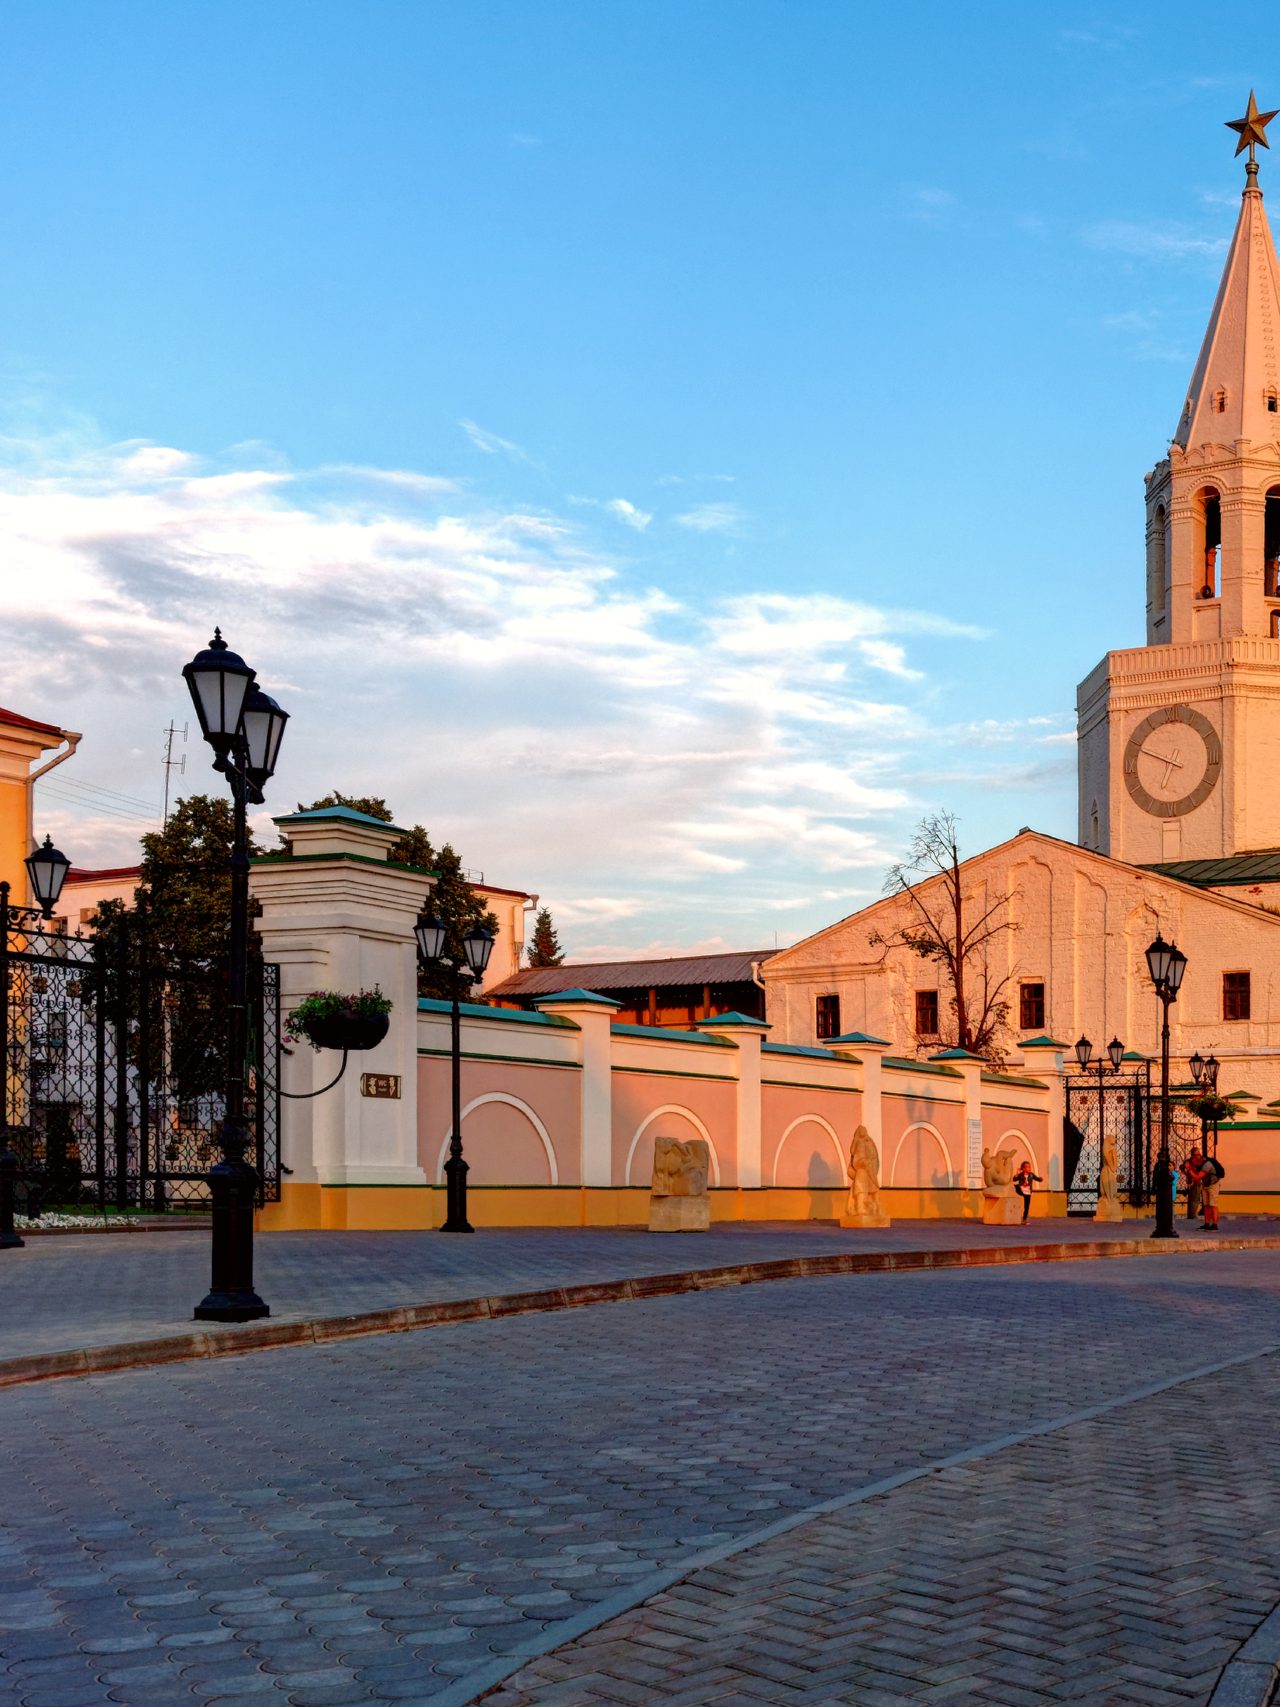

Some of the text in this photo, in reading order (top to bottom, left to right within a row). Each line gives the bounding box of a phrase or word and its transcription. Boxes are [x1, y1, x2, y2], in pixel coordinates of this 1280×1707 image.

[1165, 707, 1179, 720] XII
[1209, 751, 1219, 764] III
[1125, 759, 1136, 773] IX
[1167, 802, 1177, 816] VI
